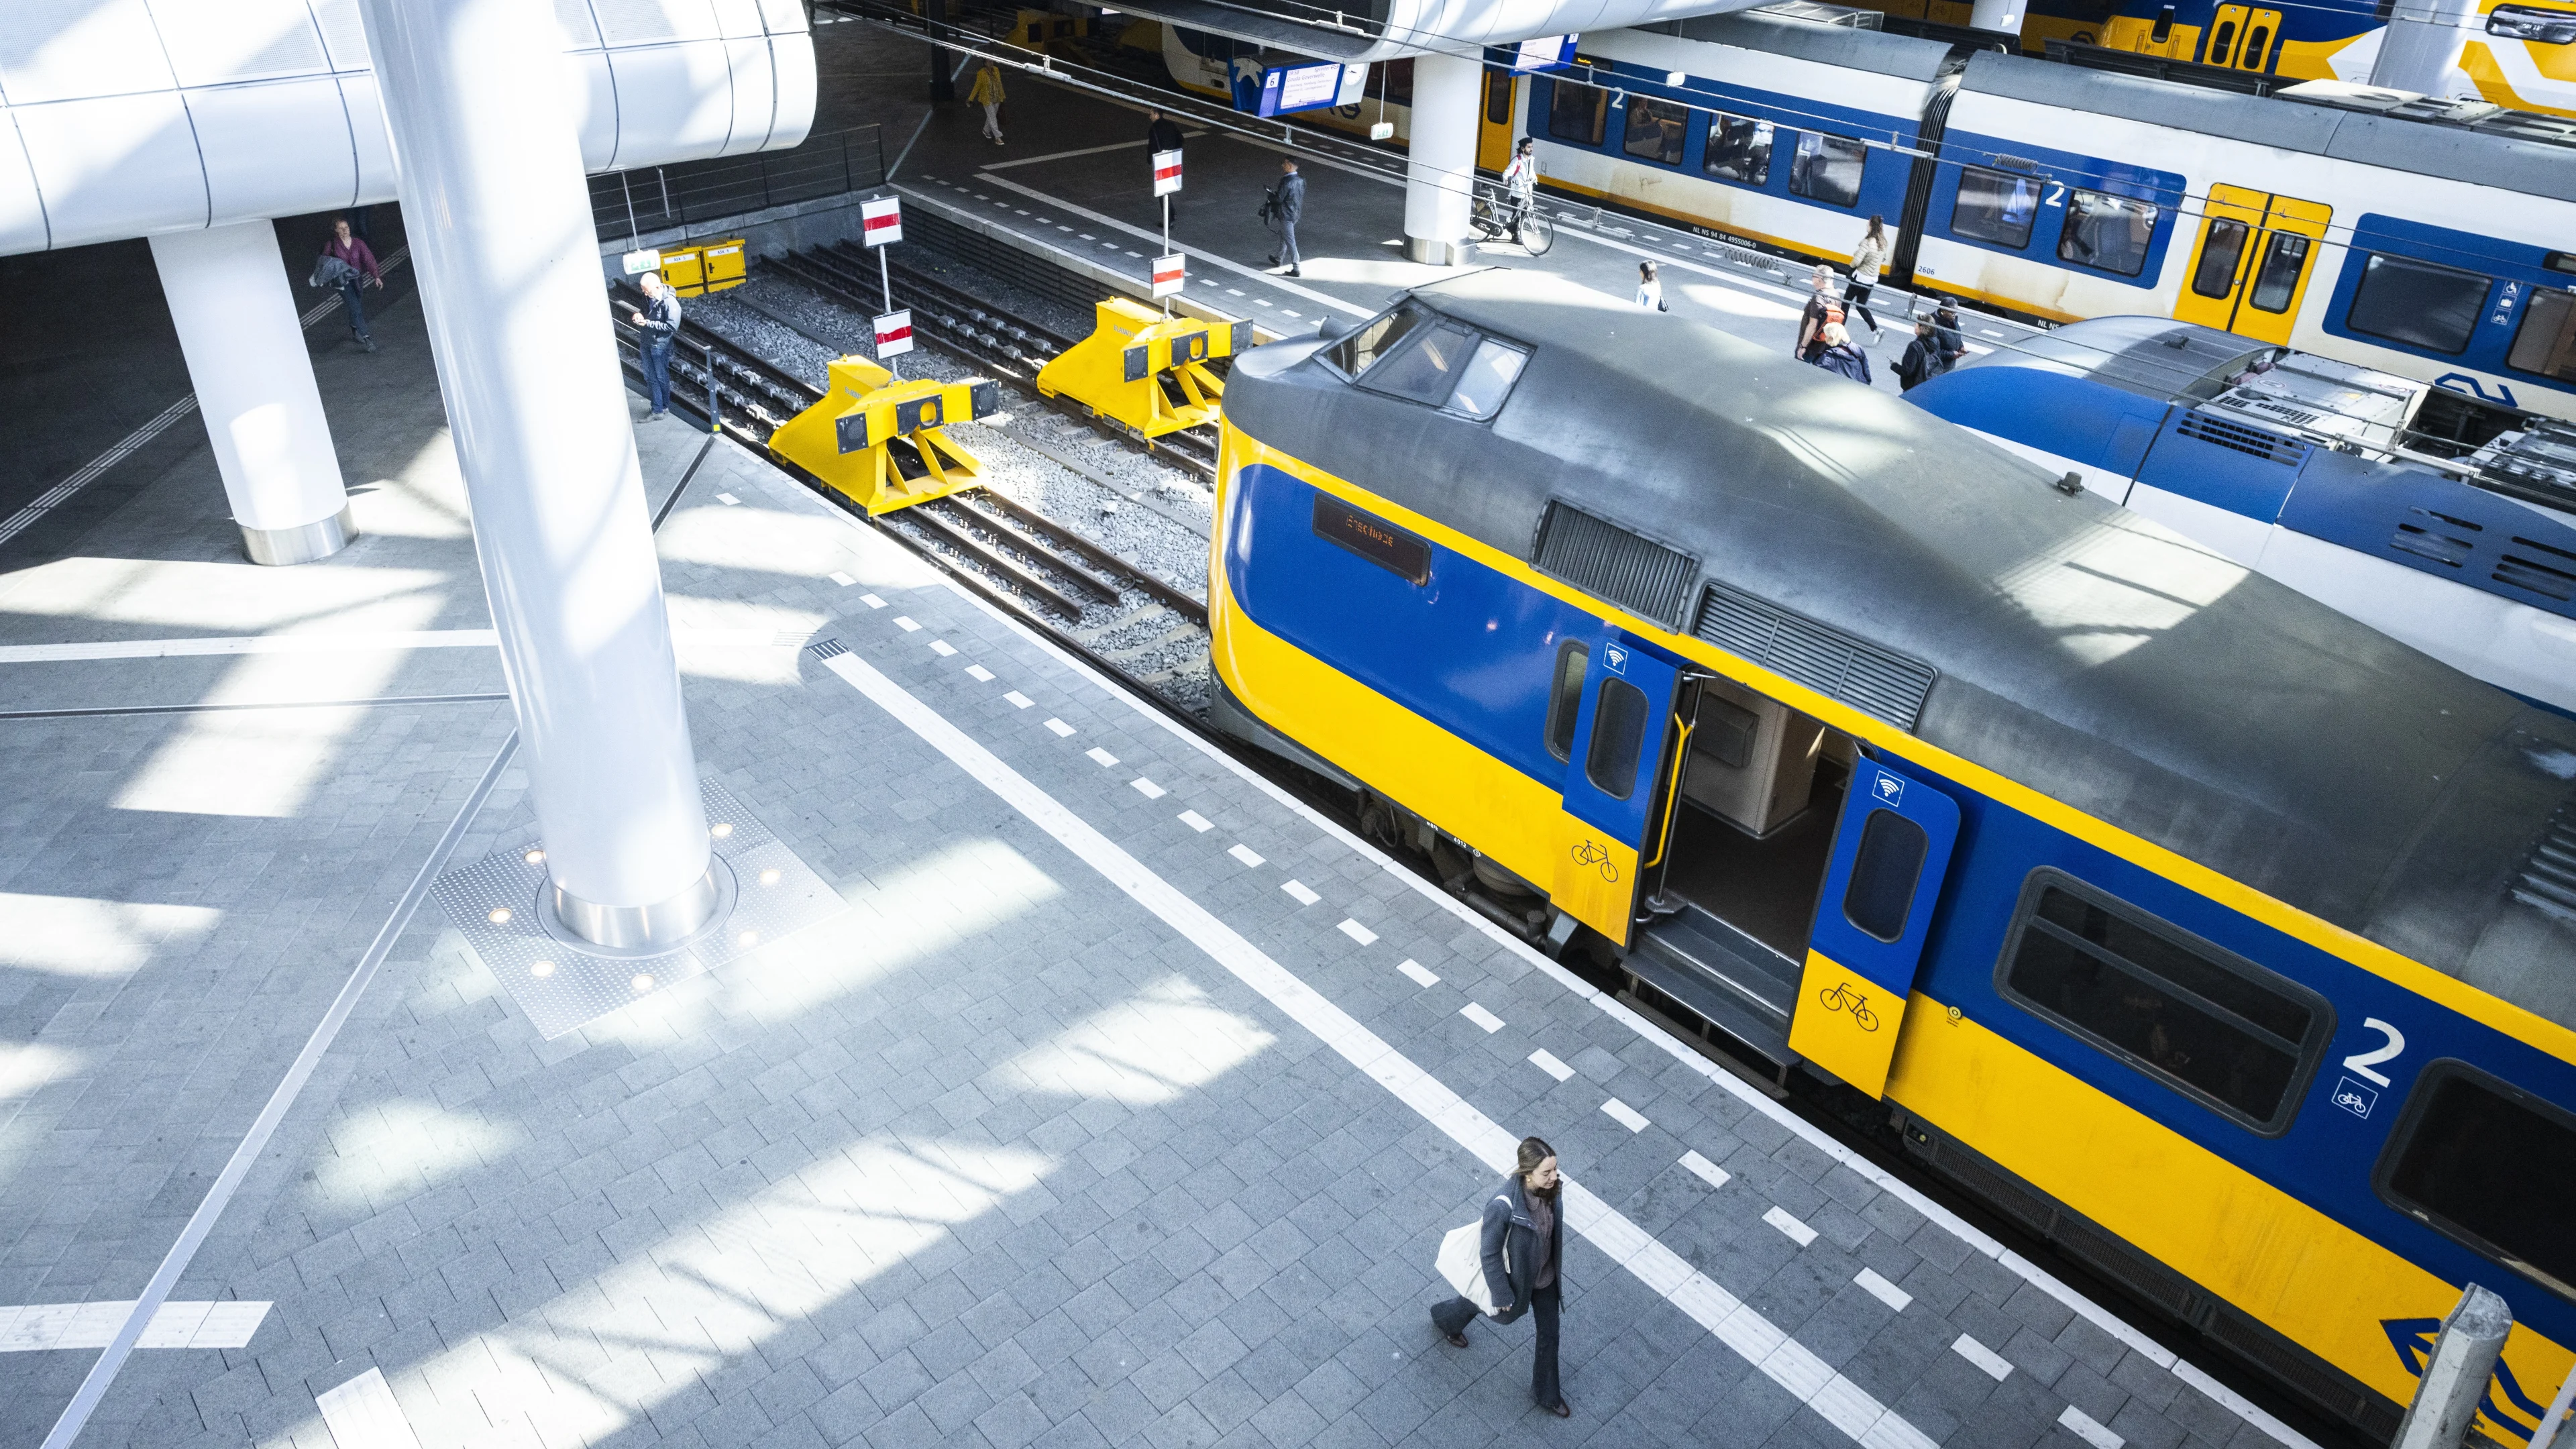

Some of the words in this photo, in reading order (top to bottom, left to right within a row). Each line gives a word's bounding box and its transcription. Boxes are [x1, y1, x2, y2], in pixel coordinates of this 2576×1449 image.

[1270, 78, 1275, 86] 6
[1612, 87, 1624, 109] 2
[2045, 180, 2065, 208] 2
[1693, 226, 1701, 234] NL
[1719, 233, 1726, 241] 84
[1727, 235, 1756, 249] 4955006-0
[1918, 266, 1935, 275] 2606
[2037, 319, 2047, 329] NL
[1453, 837, 1467, 849] 4012
[2342, 1016, 2406, 1089] 2
